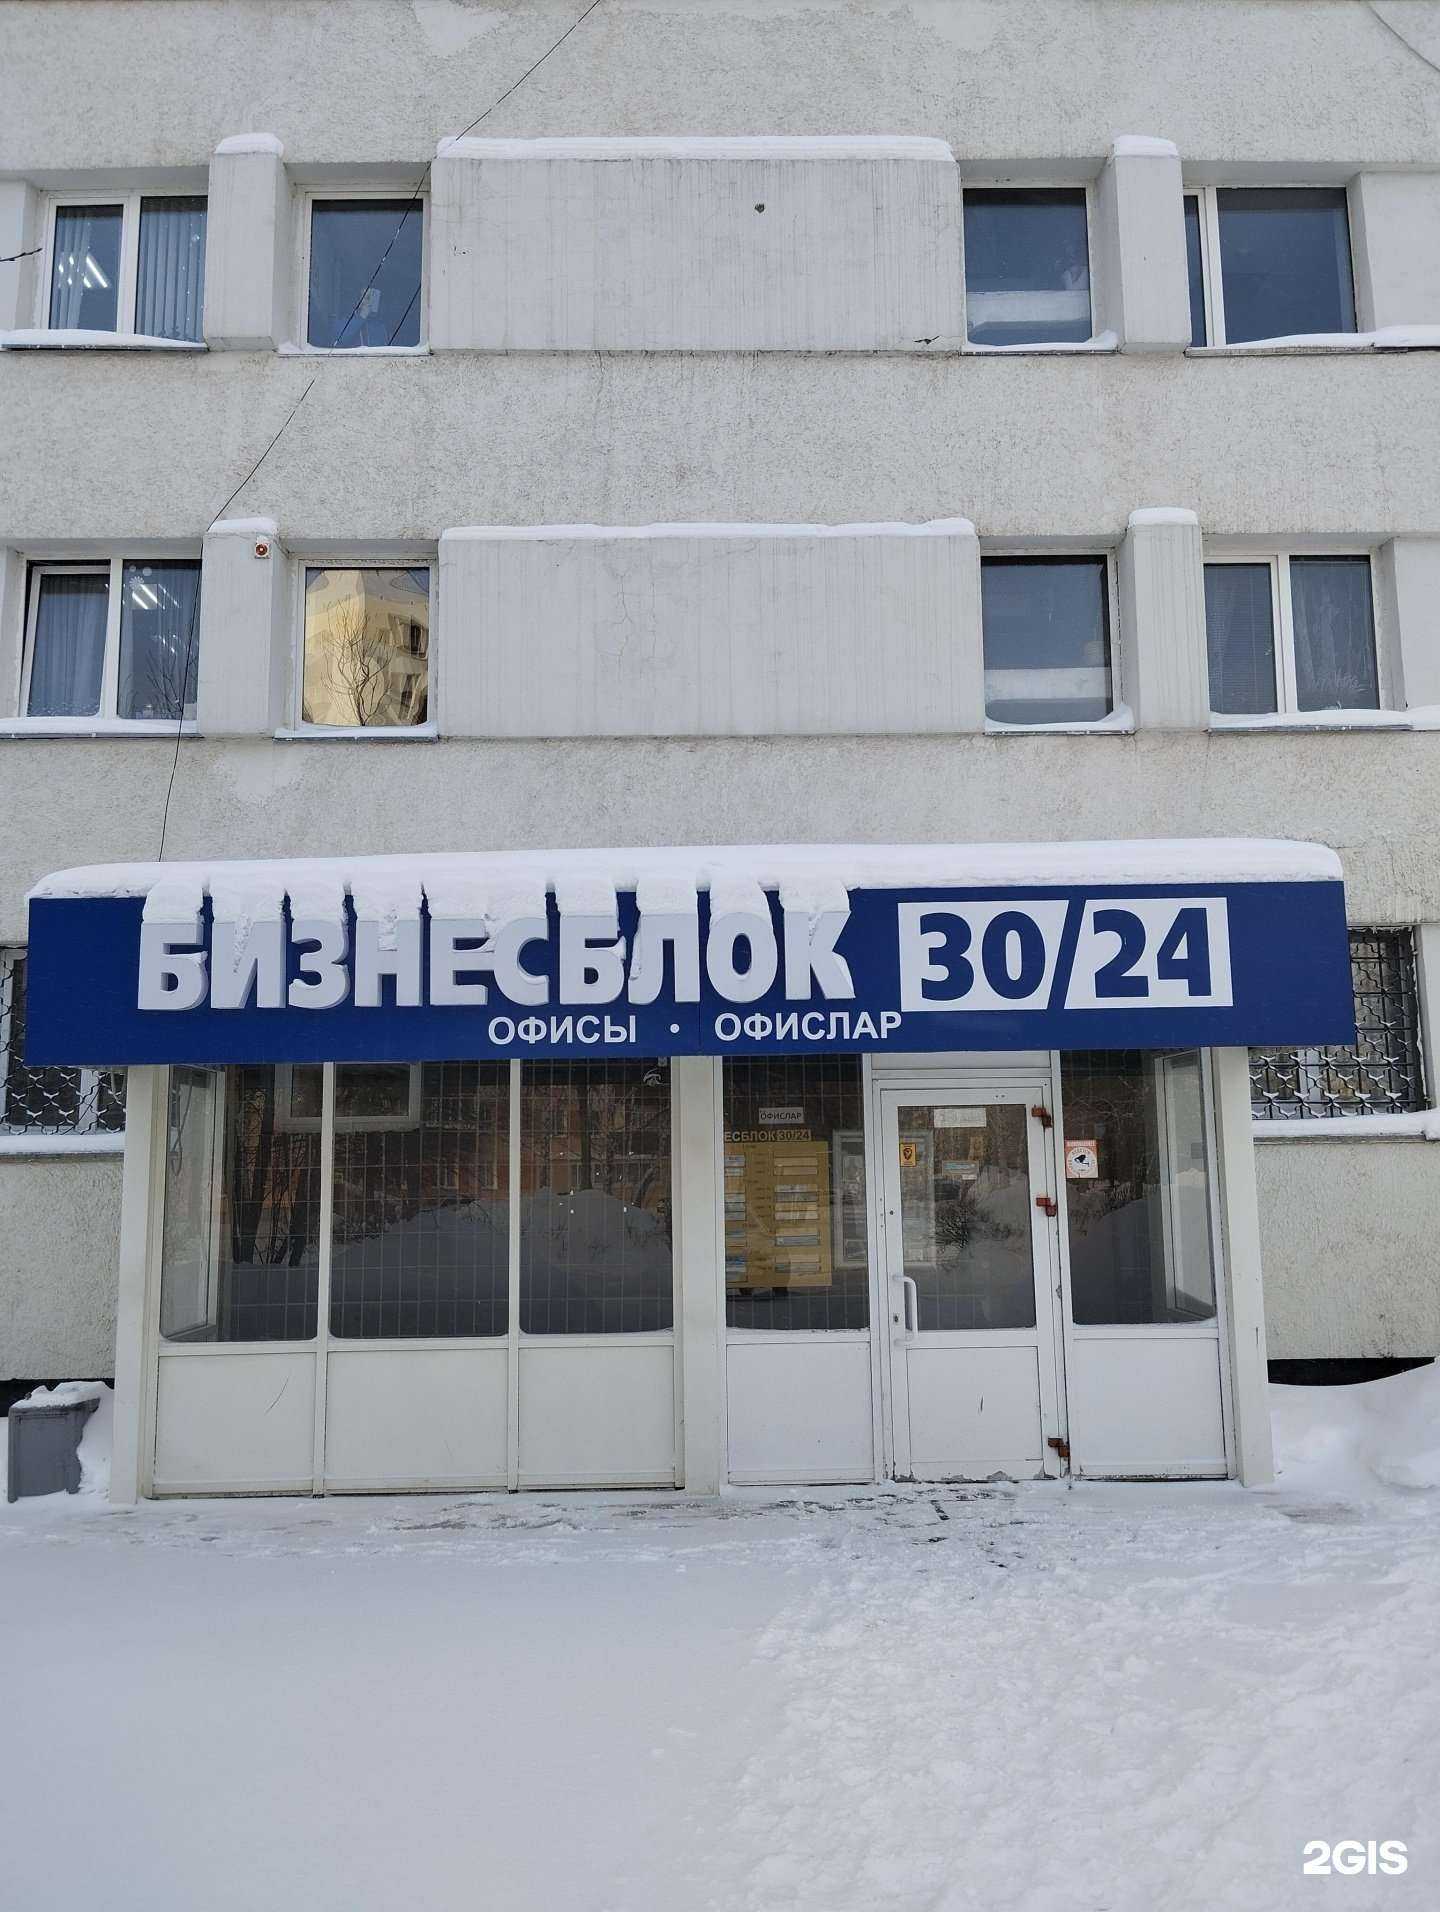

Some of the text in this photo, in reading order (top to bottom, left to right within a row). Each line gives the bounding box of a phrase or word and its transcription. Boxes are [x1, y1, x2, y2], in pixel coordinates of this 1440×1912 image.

[137, 898, 1213, 1011] БИЗНЕСБЛОК 30/24
[488, 1011, 901, 1044] ОФИСЫ ОФИСЛАР
[760, 1111, 802, 1120] ОФИСЛАР
